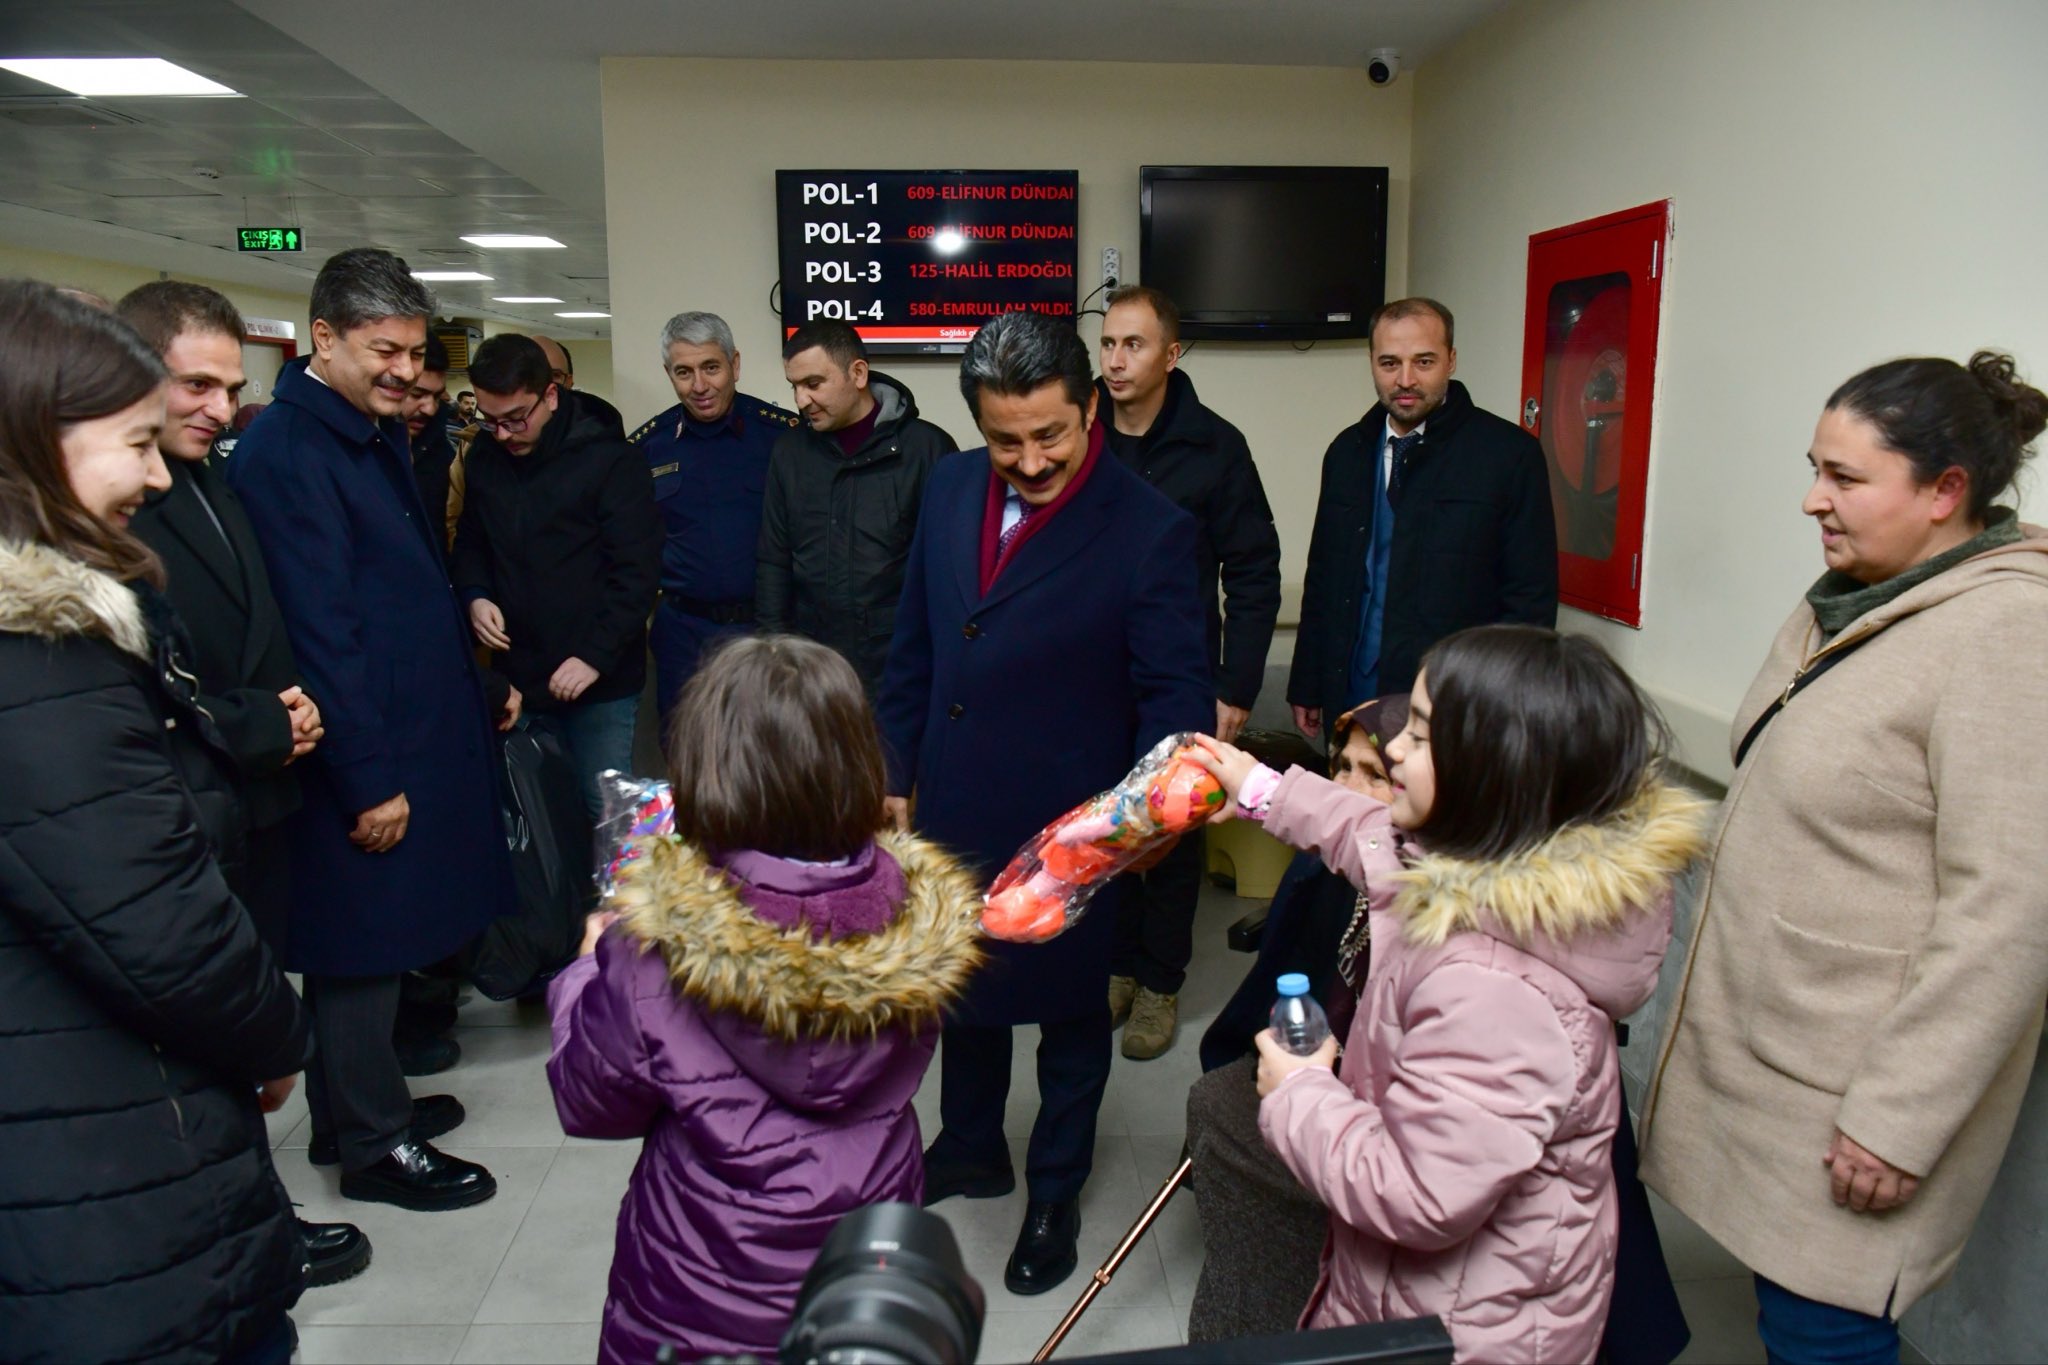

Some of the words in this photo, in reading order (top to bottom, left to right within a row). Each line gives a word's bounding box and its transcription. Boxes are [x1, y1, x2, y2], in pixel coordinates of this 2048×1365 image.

[803, 183, 878, 205] POL-1
[907, 183, 1007, 200] 609-ELİFNUR
[1010, 184, 1074, 200] DÜNDA
[241, 230, 268, 240] ÇIKIŞ
[804, 222, 881, 244] POL-2
[1010, 223, 1074, 239] DÜNDA
[805, 261, 882, 283] POL-3
[909, 262, 992, 278] 125-HALİL
[807, 300, 885, 321] POL-4
